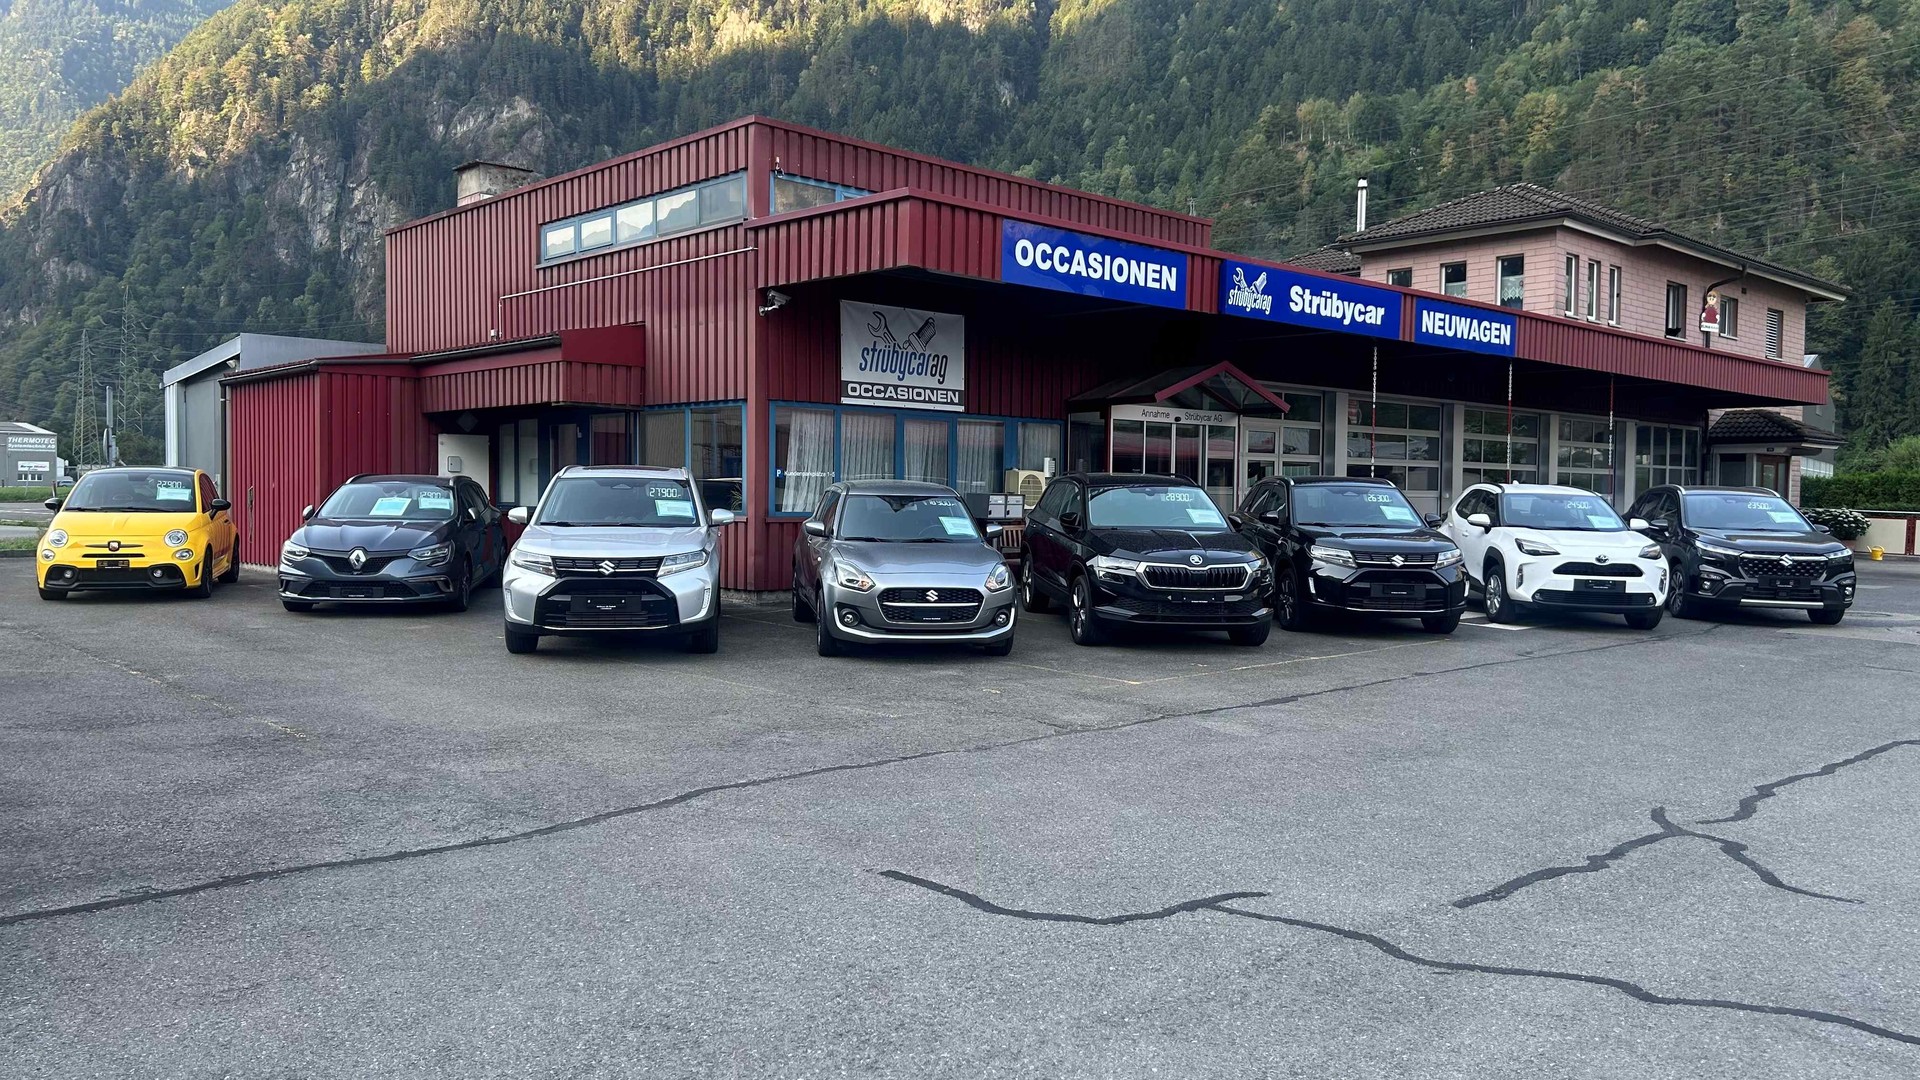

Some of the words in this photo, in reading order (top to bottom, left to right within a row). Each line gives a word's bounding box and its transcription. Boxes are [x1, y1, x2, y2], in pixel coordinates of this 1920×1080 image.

[1015, 239, 1177, 291] OCCASIONEN
[1228, 285, 1272, 315] strübycarag
[1289, 285, 1385, 325] Strübycar
[1421, 310, 1511, 345] NEUWAGEN
[859, 340, 948, 385] strübycarag
[847, 383, 959, 403] OCCASIONEN
[1141, 409, 1170, 419] Annahme
[1184, 411, 1212, 423] Strübycar
[1213, 414, 1223, 422] AG
[8, 436, 56, 444] THERMOTEC
